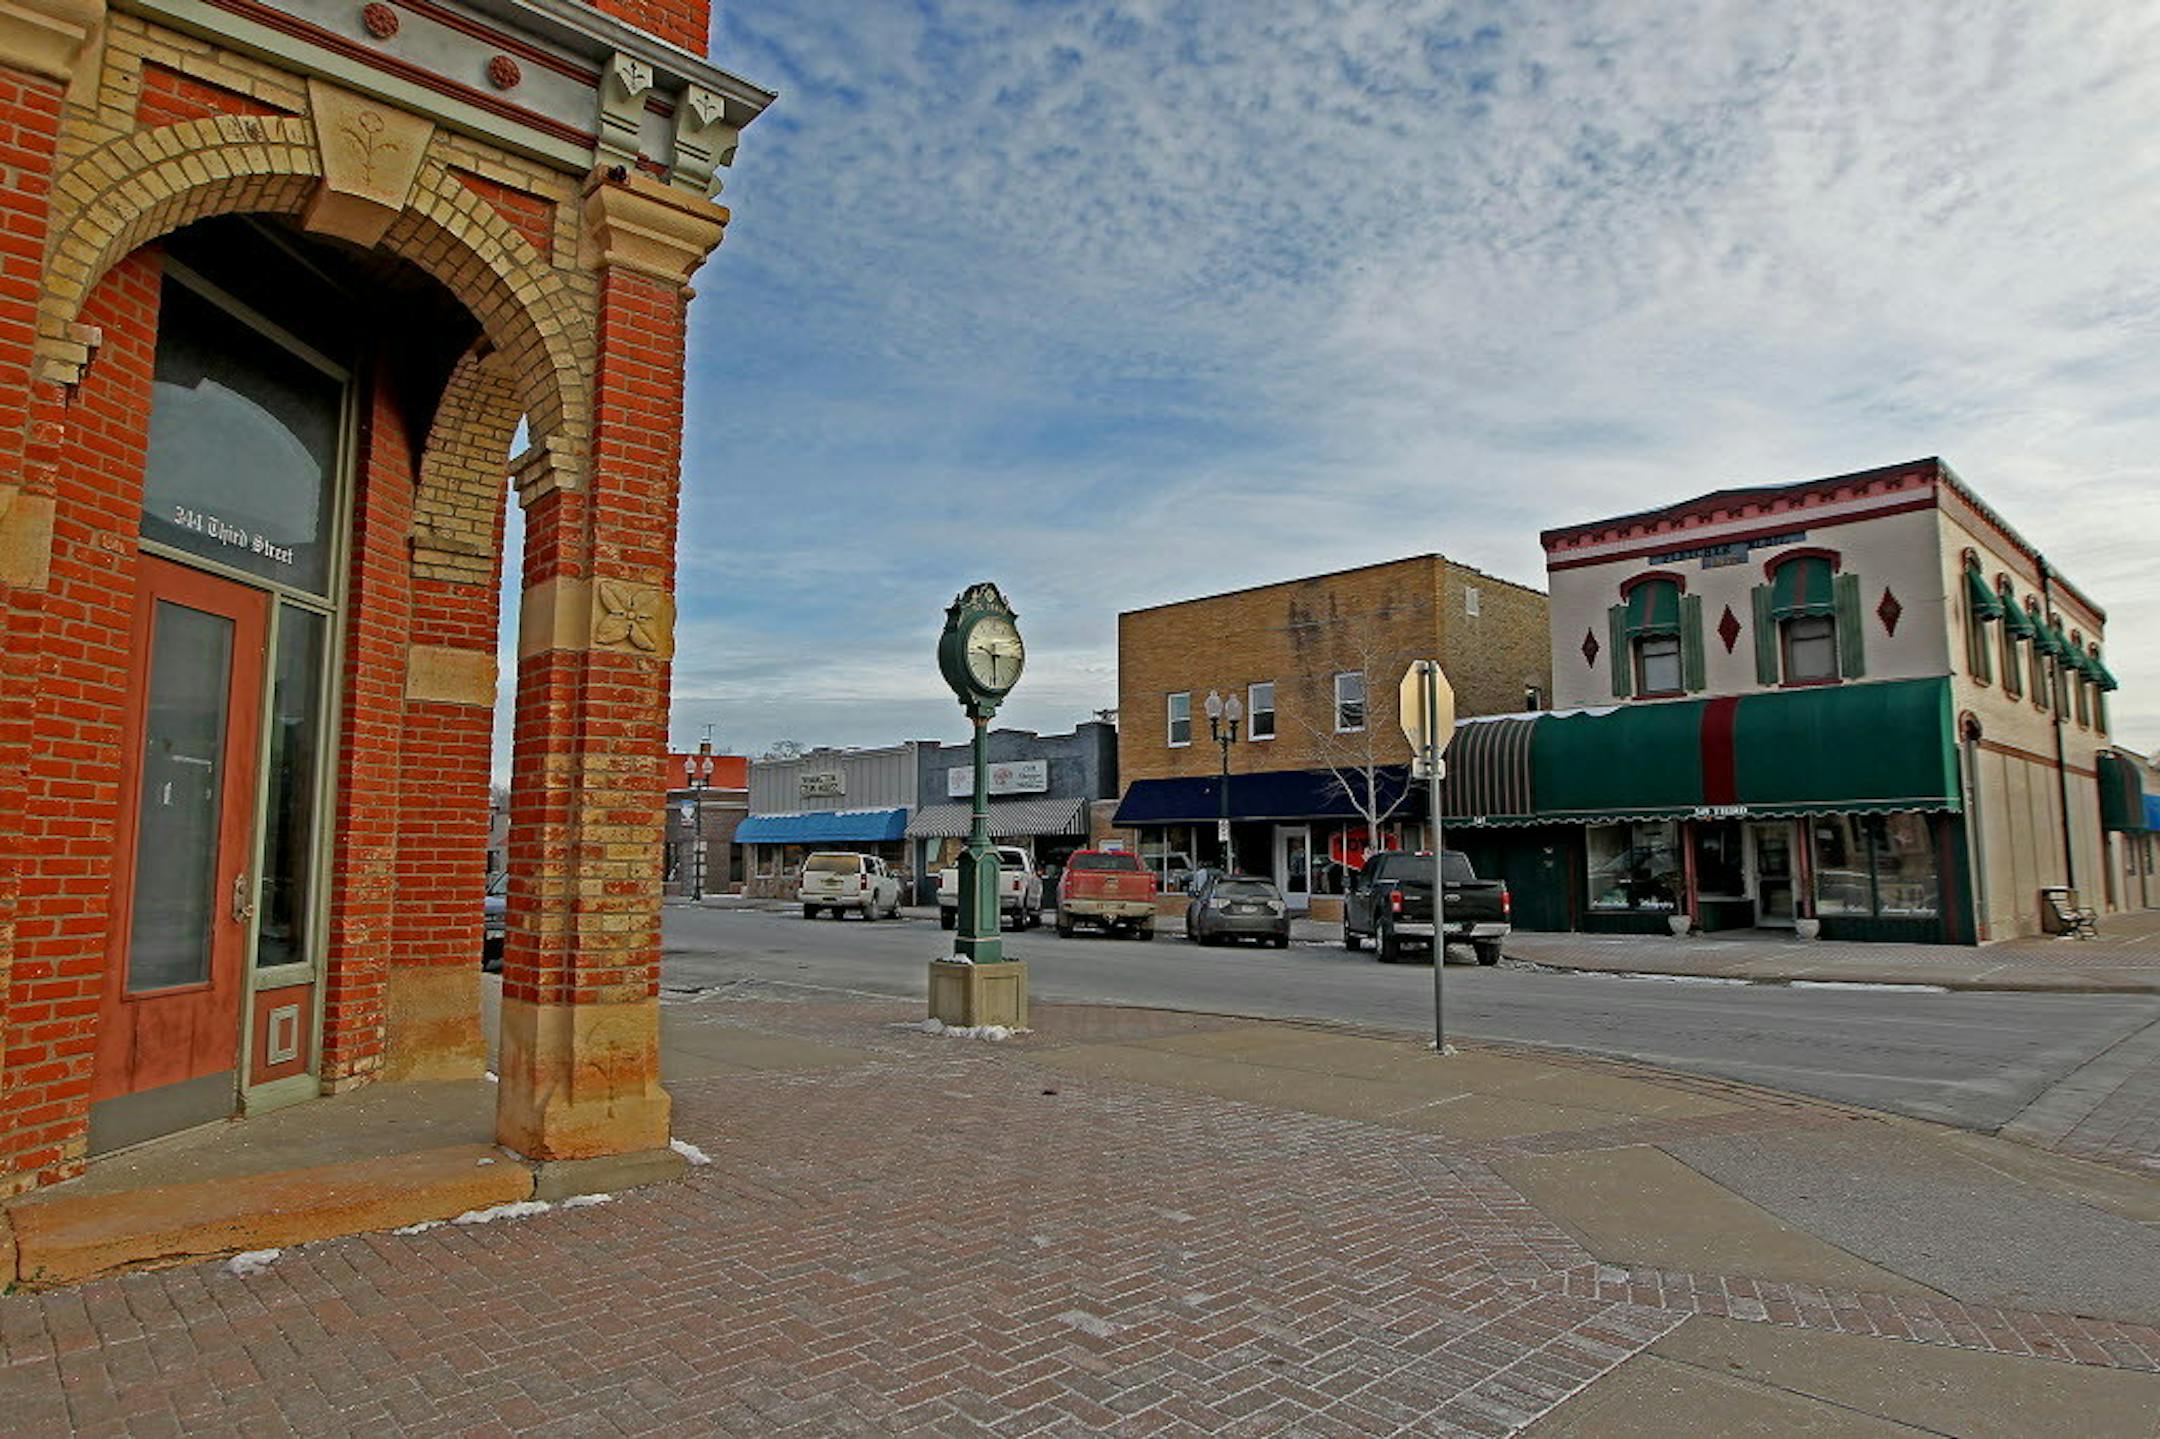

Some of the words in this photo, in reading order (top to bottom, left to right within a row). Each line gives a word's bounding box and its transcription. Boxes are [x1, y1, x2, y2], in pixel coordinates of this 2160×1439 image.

[174, 505, 203, 532] 344
[208, 515, 248, 548] Third
[252, 534, 293, 565] Street
